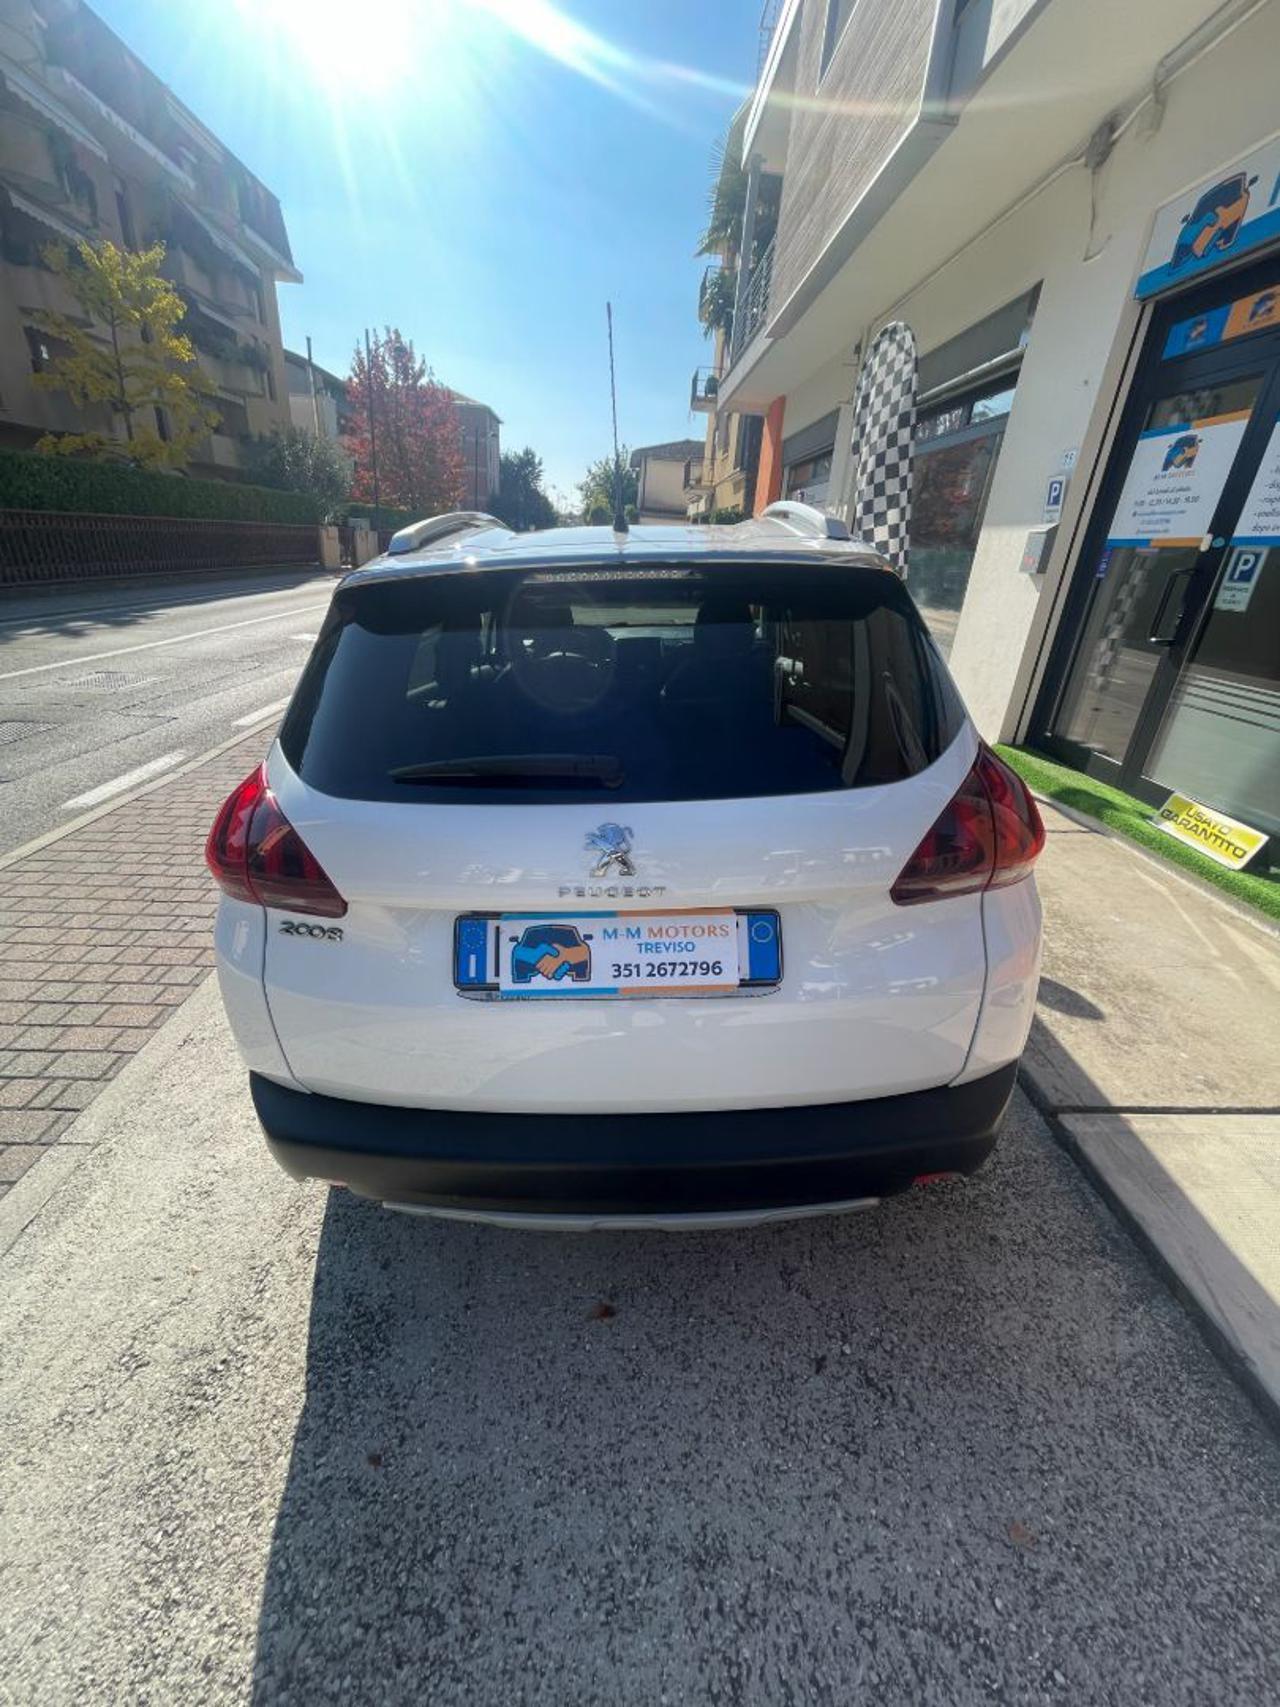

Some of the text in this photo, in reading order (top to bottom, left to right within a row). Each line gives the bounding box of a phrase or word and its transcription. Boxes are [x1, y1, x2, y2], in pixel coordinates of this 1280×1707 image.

[1050, 483, 1061, 504] P
[1234, 554, 1256, 580] P
[1186, 808, 1232, 836] USATO
[1161, 809, 1248, 859] GARANTITO
[558, 885, 667, 898] PEUGEOT
[279, 921, 344, 941] 2008
[602, 923, 730, 940] M-M MOTORS
[636, 941, 696, 955] TREVISO
[611, 960, 723, 979] 351 2672796
